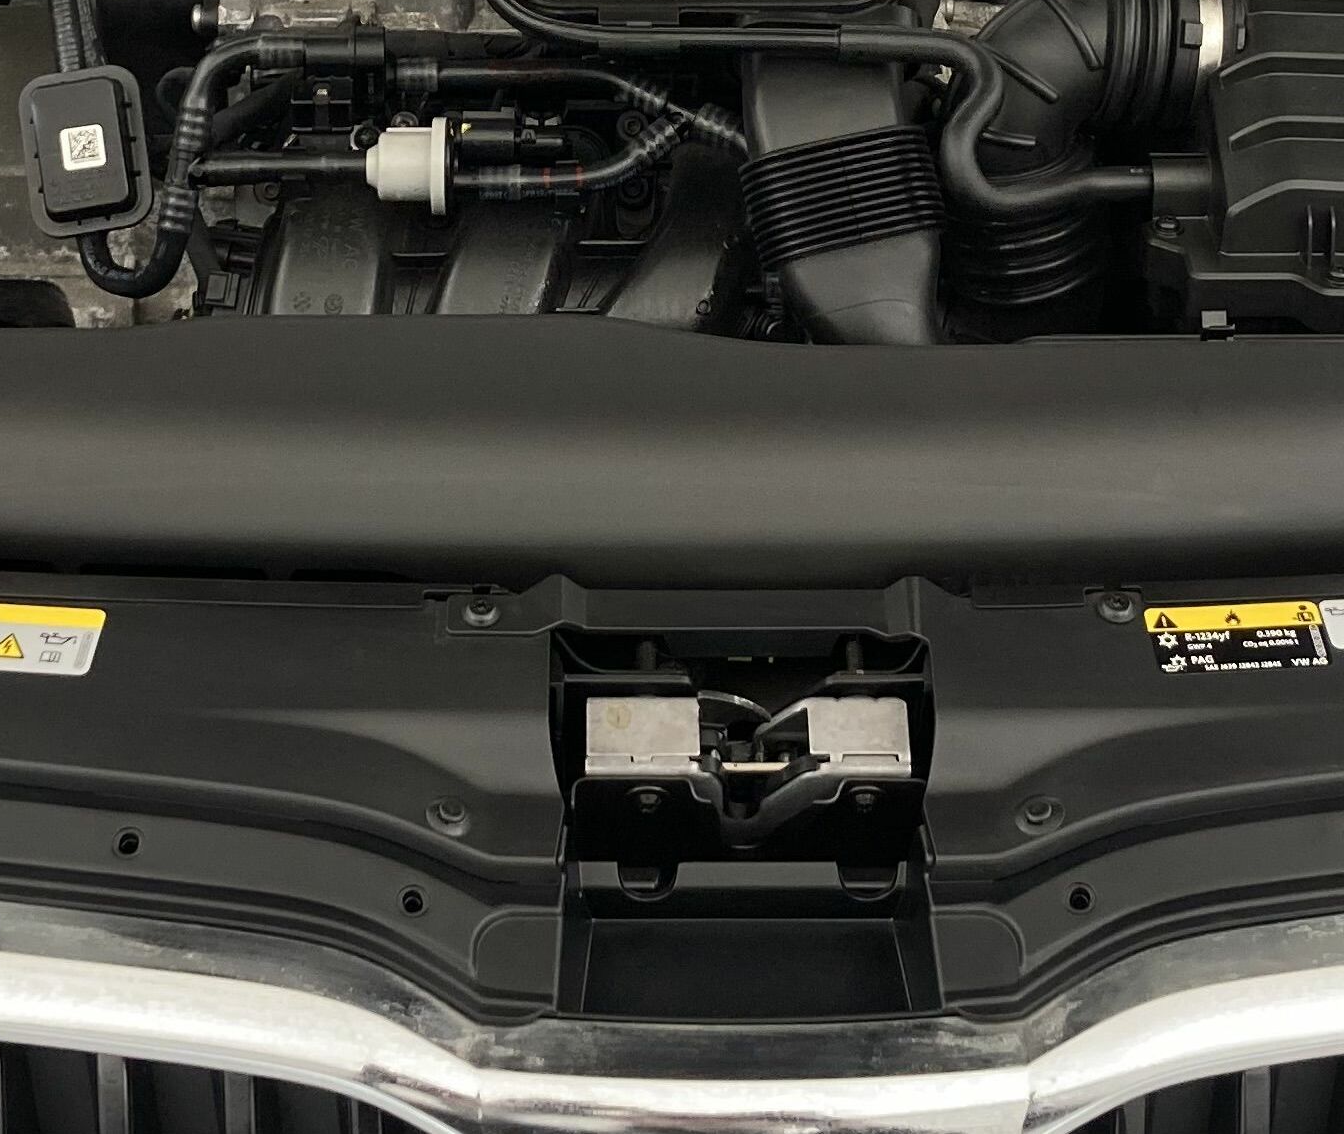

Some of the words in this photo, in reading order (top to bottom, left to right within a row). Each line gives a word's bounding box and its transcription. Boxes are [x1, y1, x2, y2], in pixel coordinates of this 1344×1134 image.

[1184, 630, 1230, 642] R-1234yf
[1283, 629, 1297, 639] kg
[1190, 654, 1215, 665] PAG
[1290, 657, 1310, 666] VW
[1311, 656, 1329, 666] AG
